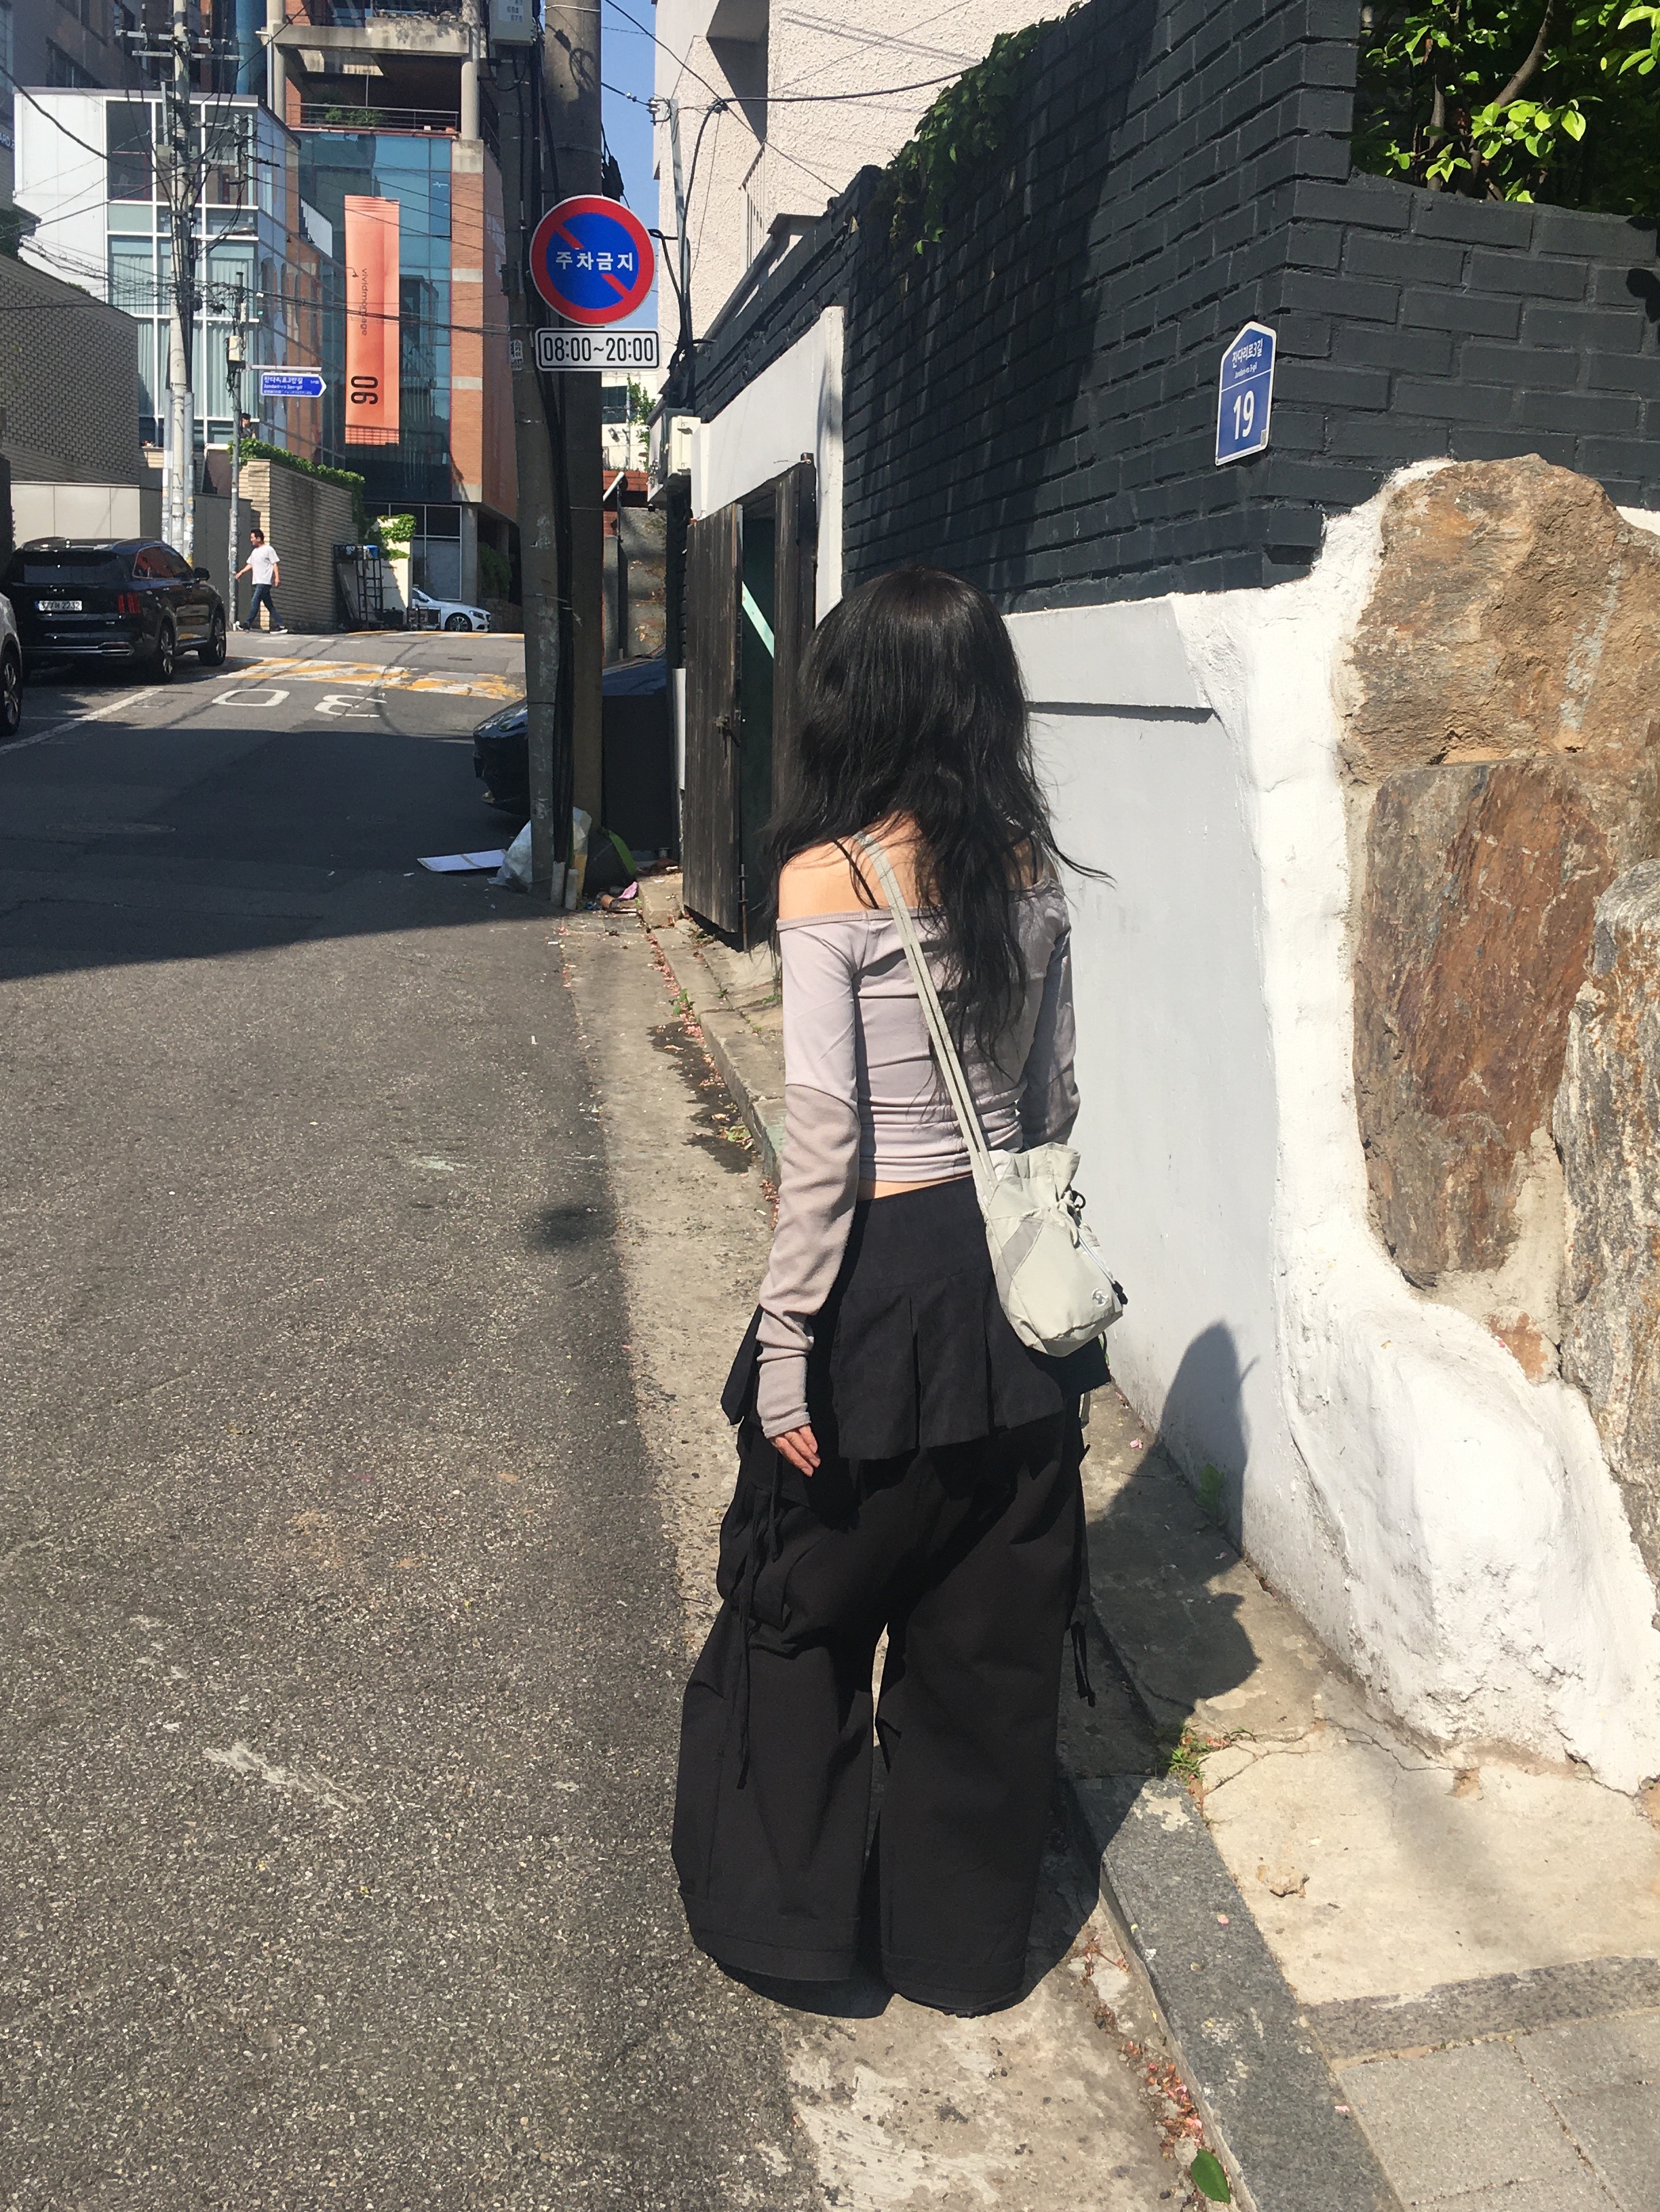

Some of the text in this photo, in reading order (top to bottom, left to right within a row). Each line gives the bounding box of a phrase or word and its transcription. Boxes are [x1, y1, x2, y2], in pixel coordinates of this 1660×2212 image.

[556, 248, 633, 271] 주차금지
[543, 337, 653, 362] 08:00~20:00
[1231, 338, 1263, 368] 잔다리로3길
[1233, 390, 1254, 440] 19
